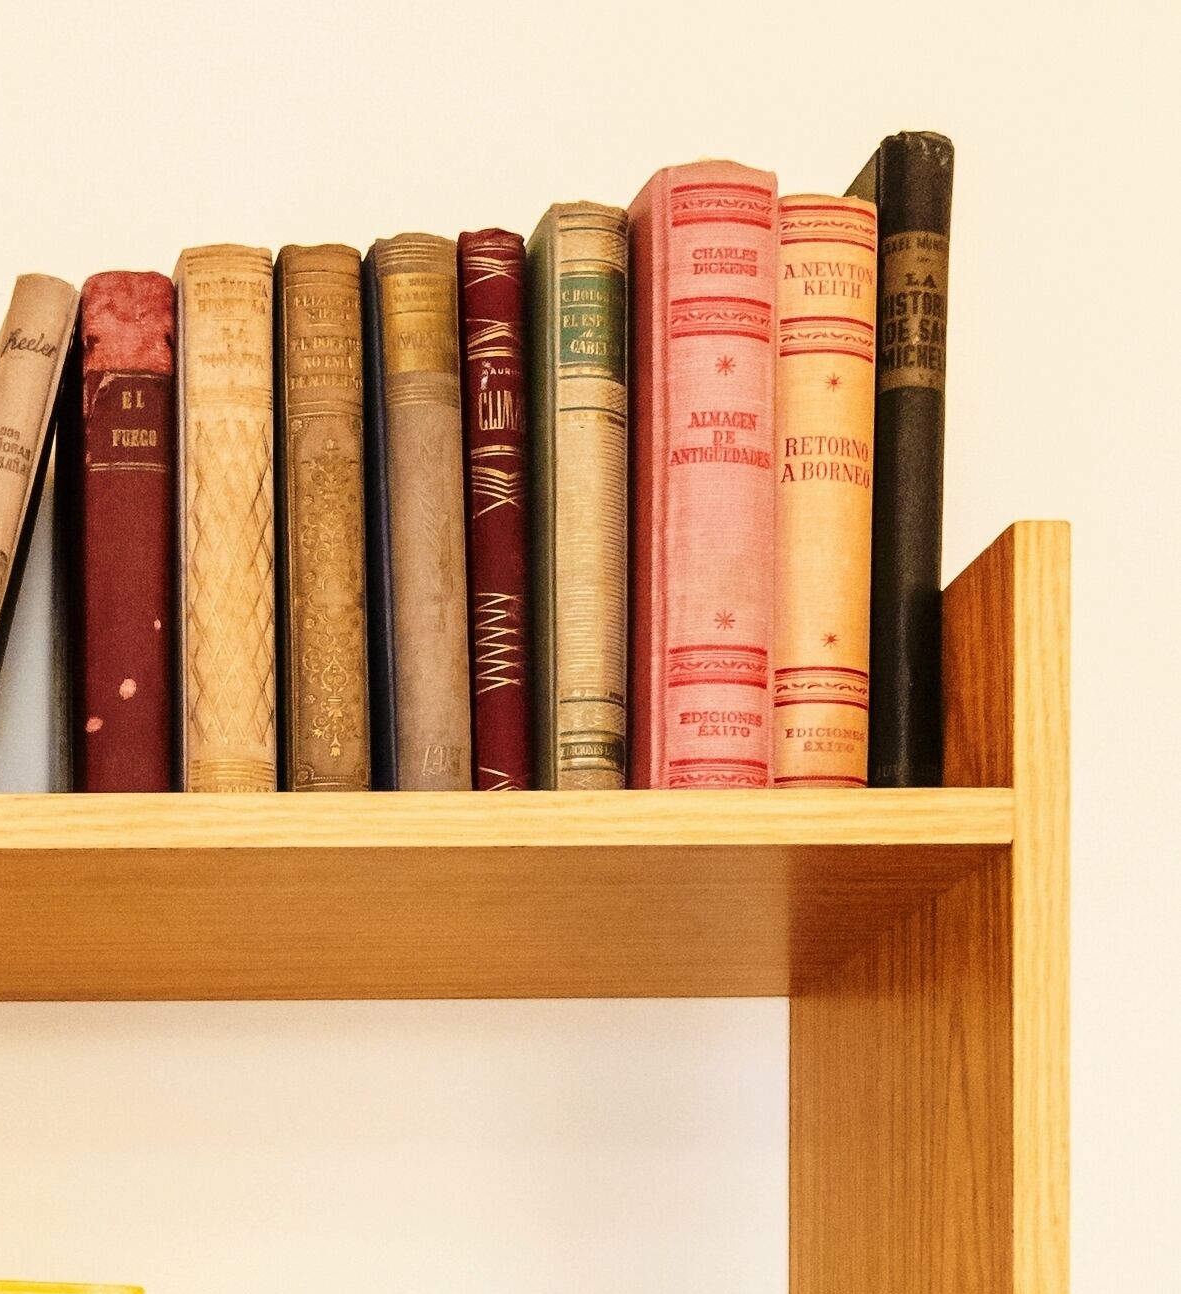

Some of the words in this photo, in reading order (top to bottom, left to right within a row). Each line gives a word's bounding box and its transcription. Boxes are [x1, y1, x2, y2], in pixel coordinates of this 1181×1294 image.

[692, 247, 758, 262] CHARLES
[692, 262, 757, 277] DICKENS
[801, 262, 874, 285] NEWTON
[904, 272, 937, 288] LA
[803, 280, 861, 299] KEITH
[884, 319, 910, 345] DE
[122, 390, 145, 409] EL
[687, 411, 758, 431] ALMACEN
[112, 429, 157, 447] FUEGO
[713, 431, 735, 444] DE
[785, 436, 869, 462] RETORNO
[780, 463, 796, 483] A
[801, 461, 870, 489] BORNEO
[680, 711, 763, 728] EDICIONES
[785, 728, 866, 742] EDICIONES
